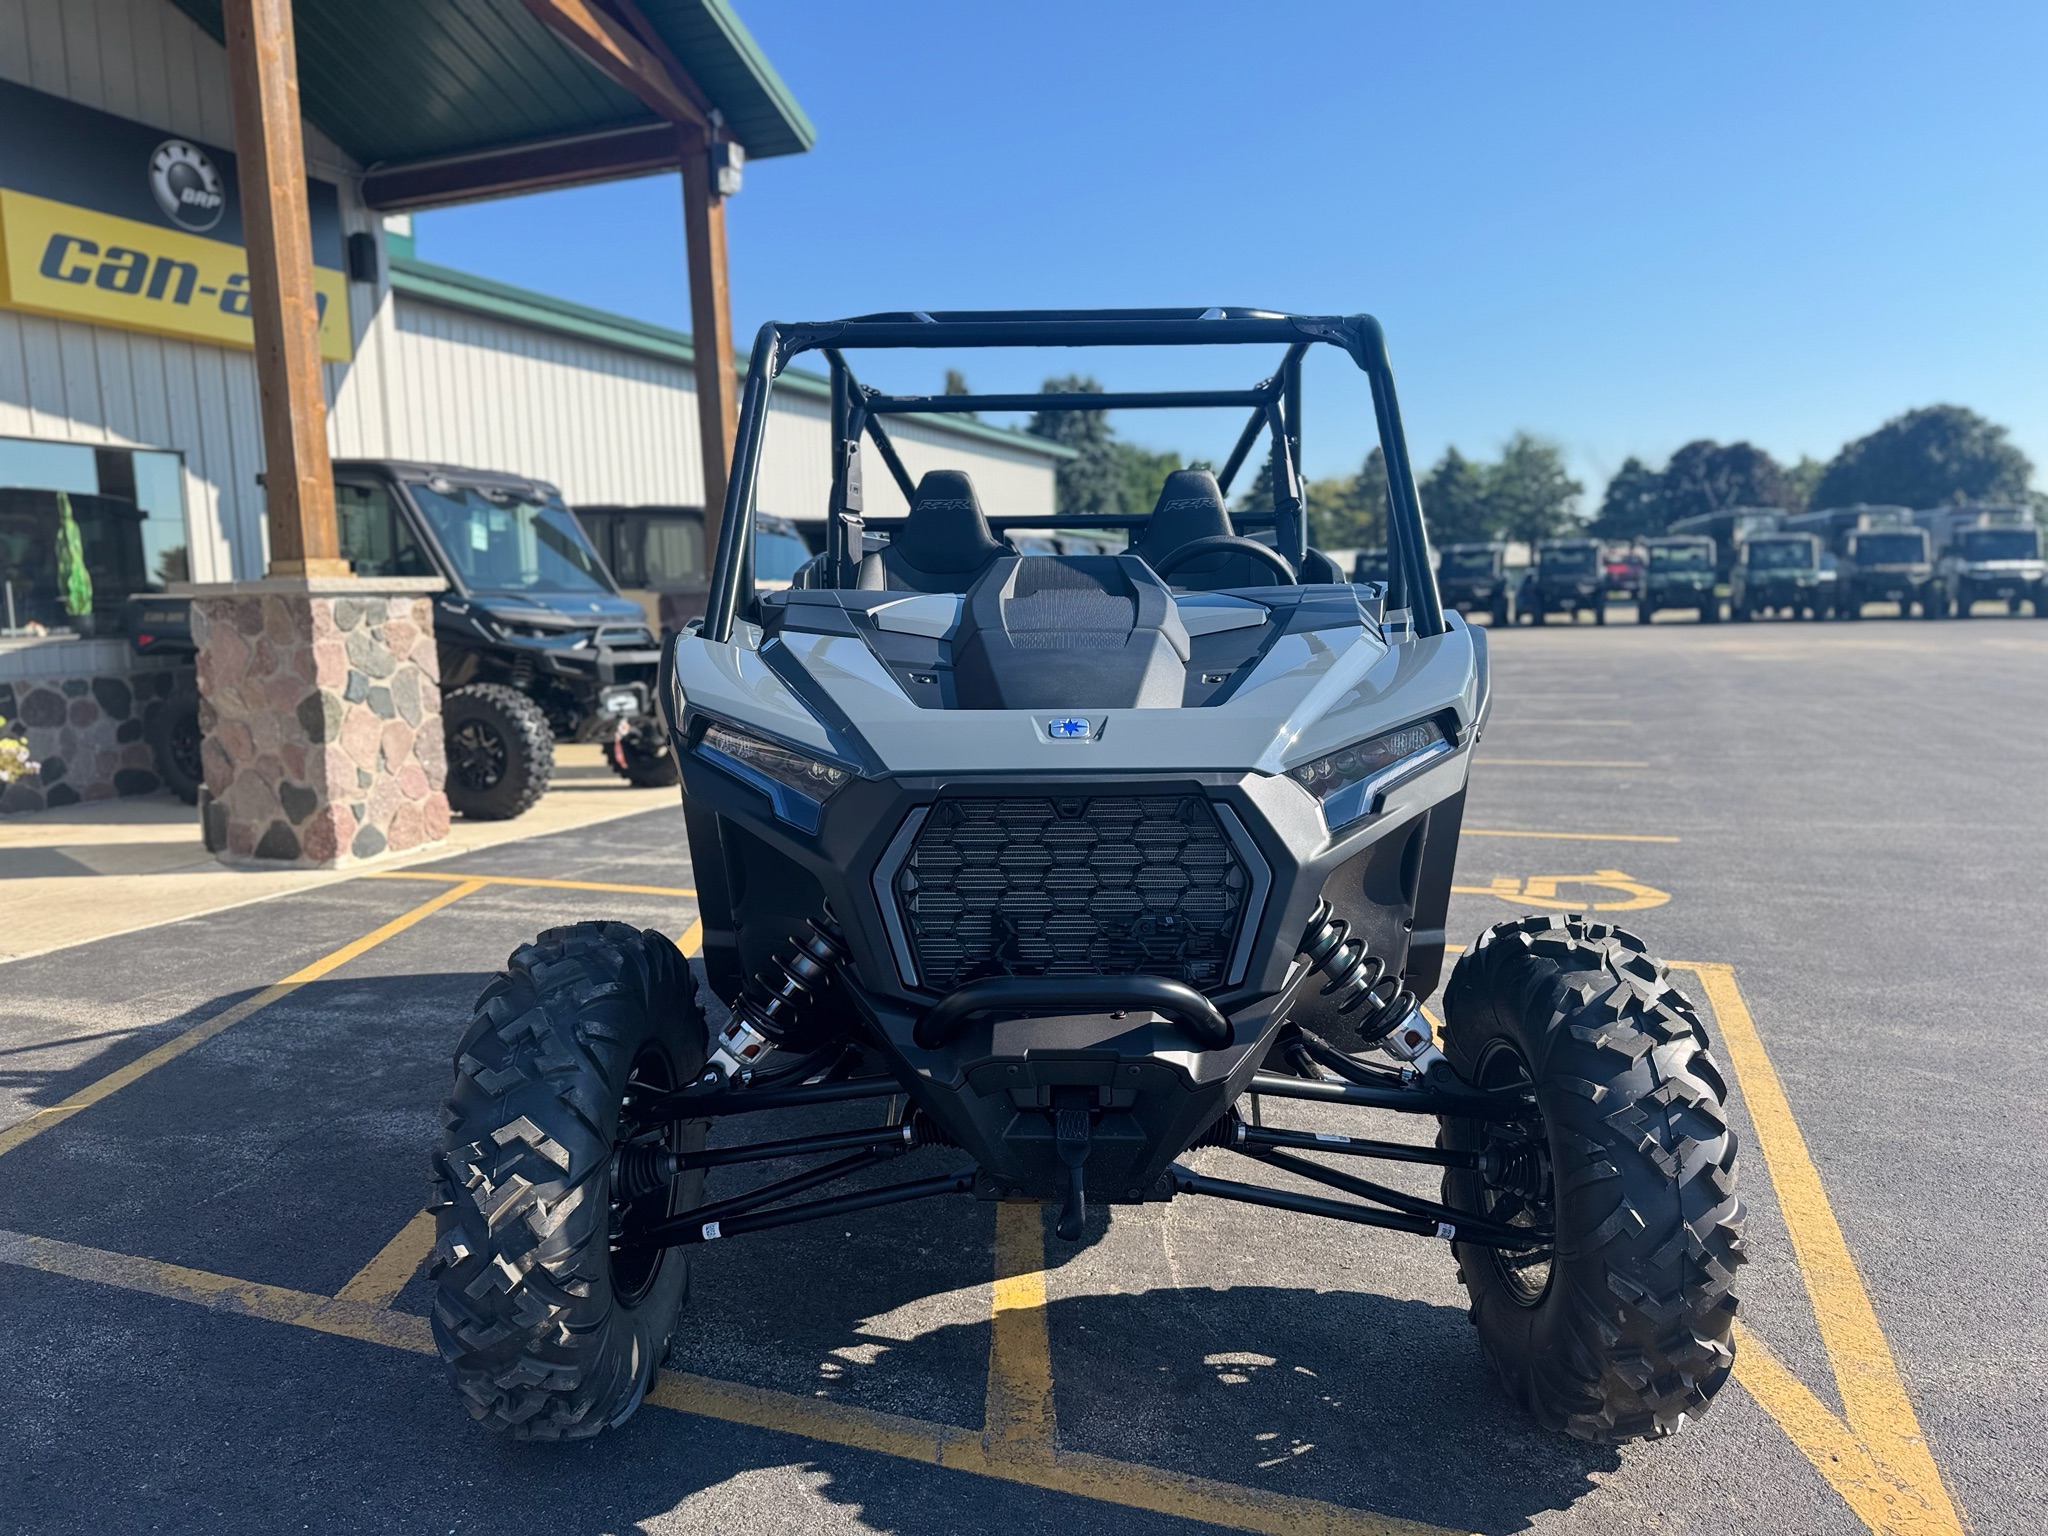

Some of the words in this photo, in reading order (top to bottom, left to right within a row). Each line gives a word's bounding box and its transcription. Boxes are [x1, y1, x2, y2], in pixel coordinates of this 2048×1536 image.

[181, 187, 221, 209] BRP
[917, 499, 970, 511] RZR
[1163, 497, 1217, 512] RZR
